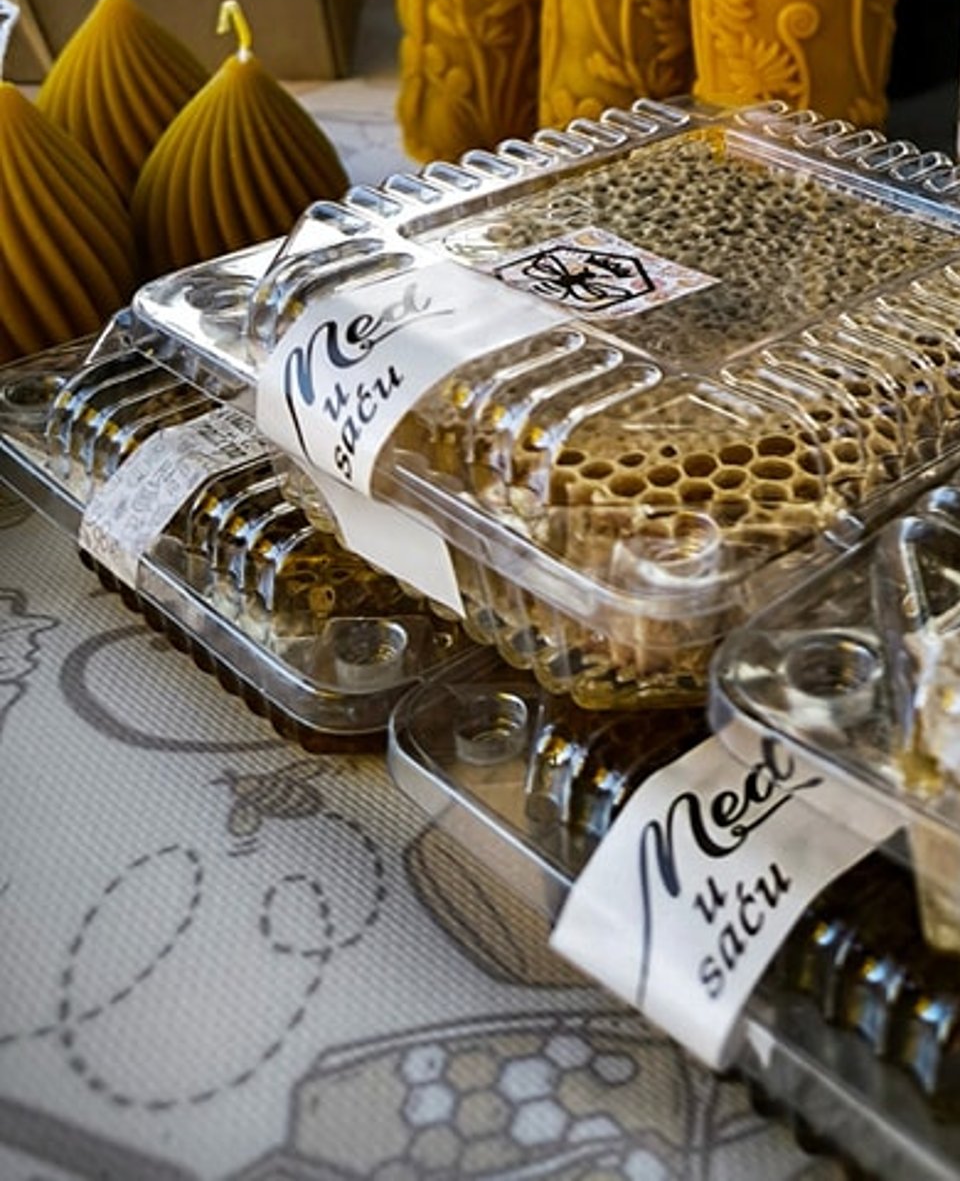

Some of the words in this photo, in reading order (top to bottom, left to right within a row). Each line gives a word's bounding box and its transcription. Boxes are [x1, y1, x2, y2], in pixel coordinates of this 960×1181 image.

[284, 282, 454, 468] Med
[323, 382, 349, 421] u
[635, 735, 825, 1008] Med
[692, 875, 728, 924] u
